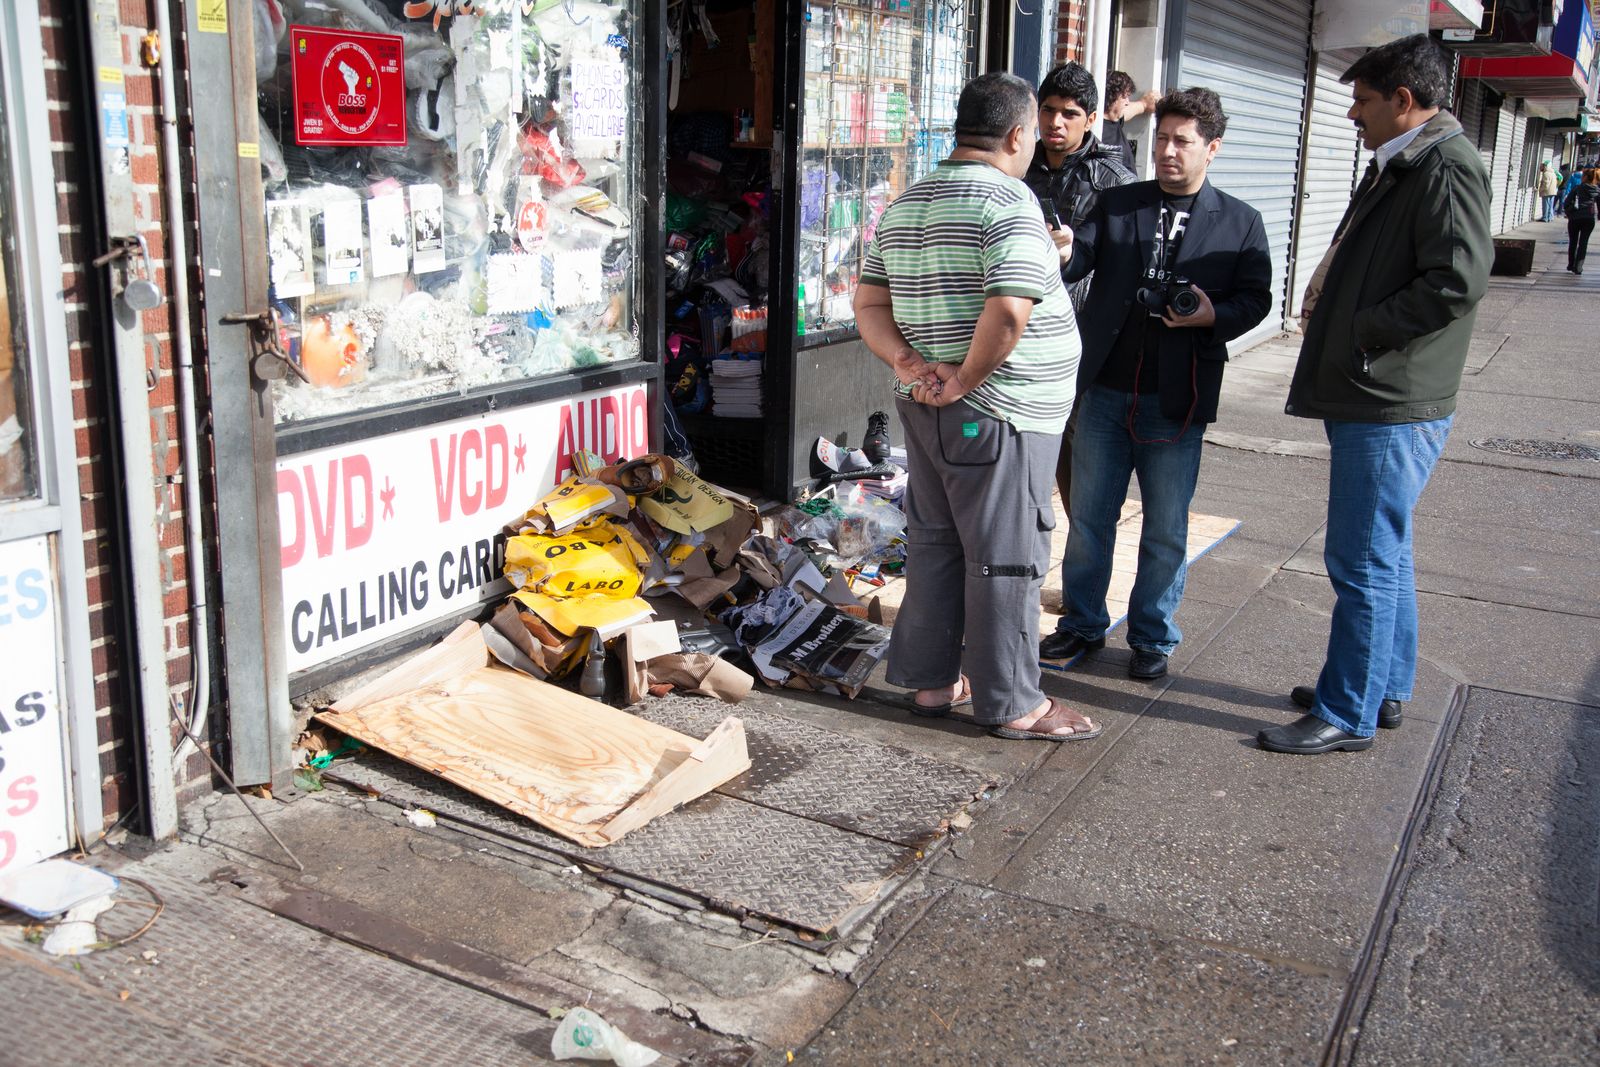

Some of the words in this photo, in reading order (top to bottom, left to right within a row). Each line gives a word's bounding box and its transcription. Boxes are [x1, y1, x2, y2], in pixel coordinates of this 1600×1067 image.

[338, 93, 367, 107] BOSS
[554, 388, 649, 486] AUDIO
[674, 467, 700, 486] RICAN
[697, 484, 726, 506] DESIGN
[291, 560, 430, 655] CALLING
[438, 532, 507, 600] CARD
[565, 579, 624, 592] LABO
